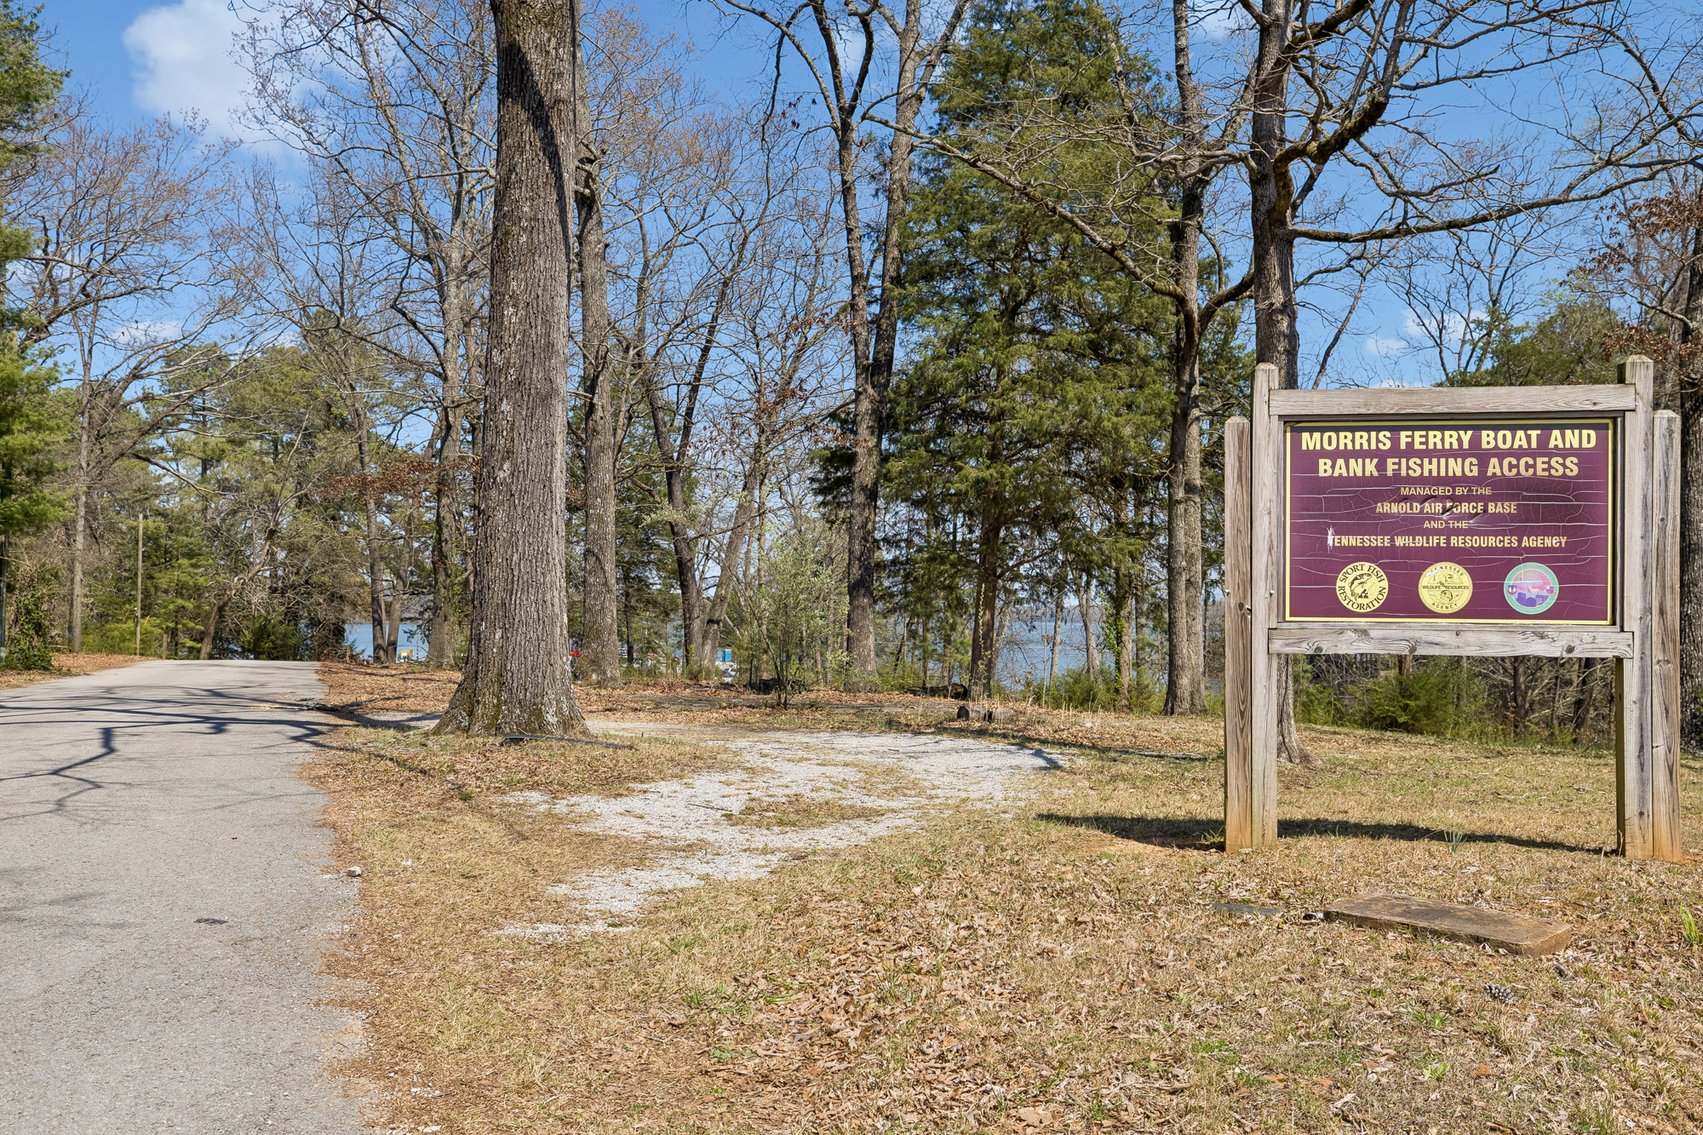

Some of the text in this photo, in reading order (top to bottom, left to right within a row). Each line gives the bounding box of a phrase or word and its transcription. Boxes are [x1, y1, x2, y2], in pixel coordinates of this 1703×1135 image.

[1302, 430, 1597, 450] MORRIS FERRY BOAT AND
[1318, 456, 1580, 477] BANK FISHING ACCESS
[1400, 486, 1492, 496] MANAGED BY THE
[1376, 502, 1518, 514] ARNOLD AIR FORCE BASE
[1424, 520, 1469, 529] AND THE
[1328, 535, 1568, 548] ENNESSEE WILDLIFE RESOURCES AGENCY
[1340, 564, 1386, 583] SPORT FISH
[1338, 586, 1387, 610] RESTORATION
